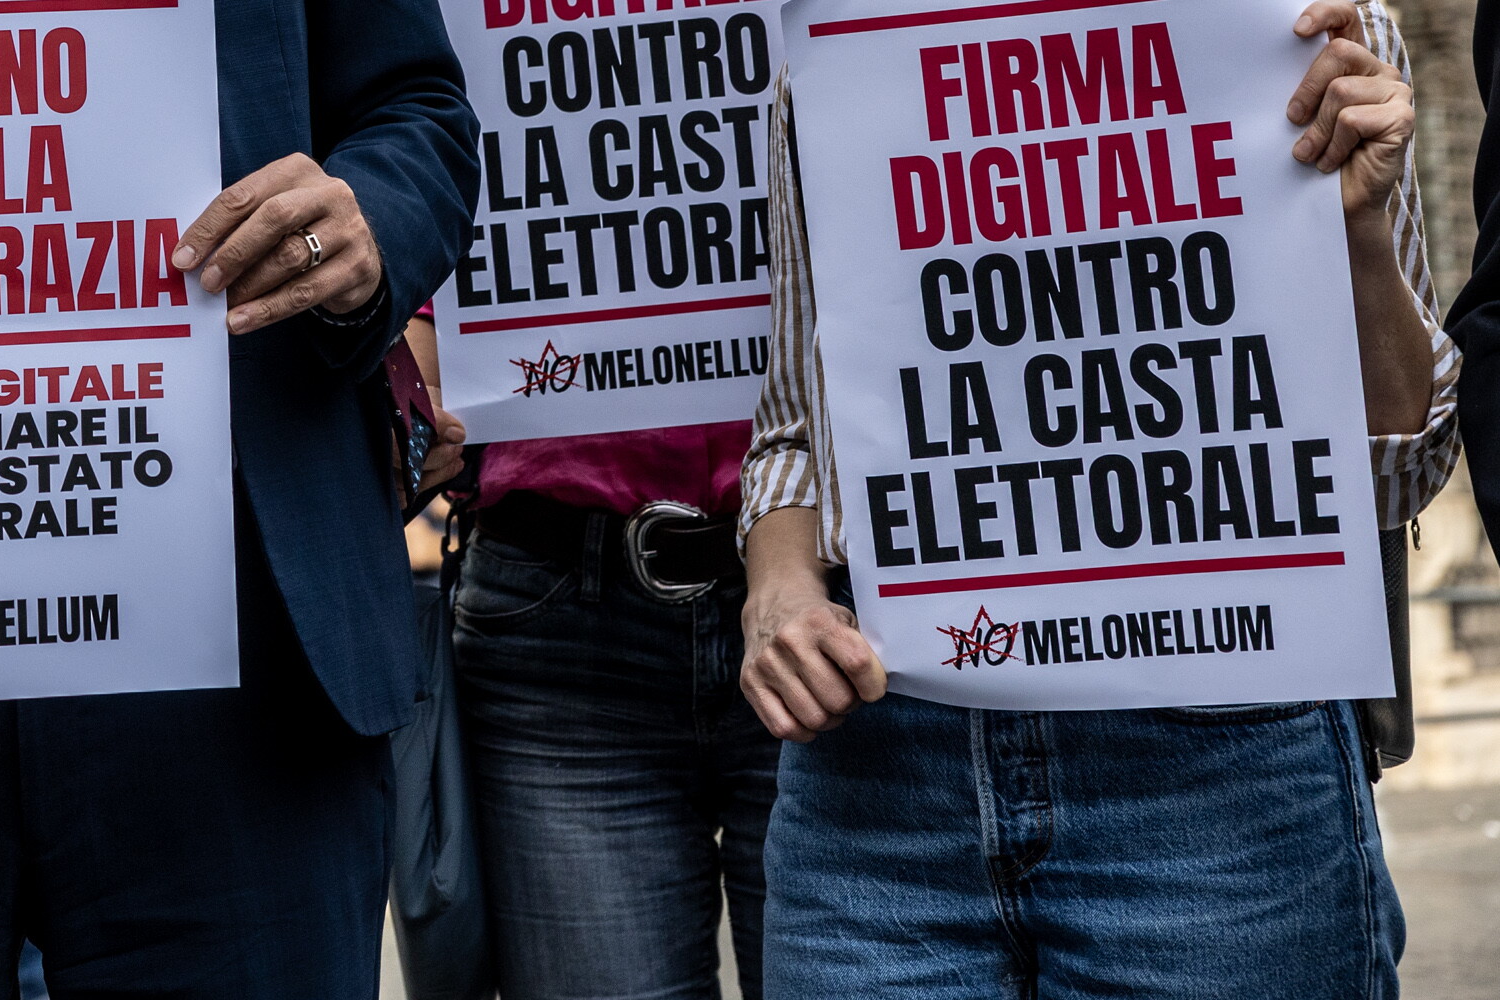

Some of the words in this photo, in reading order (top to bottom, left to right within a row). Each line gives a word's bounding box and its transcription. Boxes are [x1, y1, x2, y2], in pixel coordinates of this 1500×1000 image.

[503, 13, 770, 117] CONTRO
[919, 22, 1187, 141] FIRMA
[482, 126, 569, 212] LA
[589, 104, 772, 201] CAST
[889, 121, 1243, 250] DIGITALE
[455, 196, 772, 309] ELETTORA
[921, 231, 1235, 351] CONTRO
[523, 354, 576, 398] NO
[583, 335, 770, 392] MELONELLU
[899, 361, 1002, 460] LA
[1024, 334, 1283, 447] CASTA
[118, 406, 159, 444] IL
[866, 438, 1340, 567] ELETTORALE
[953, 622, 1013, 671] NO
[1022, 605, 1274, 666] MELONELLUM
